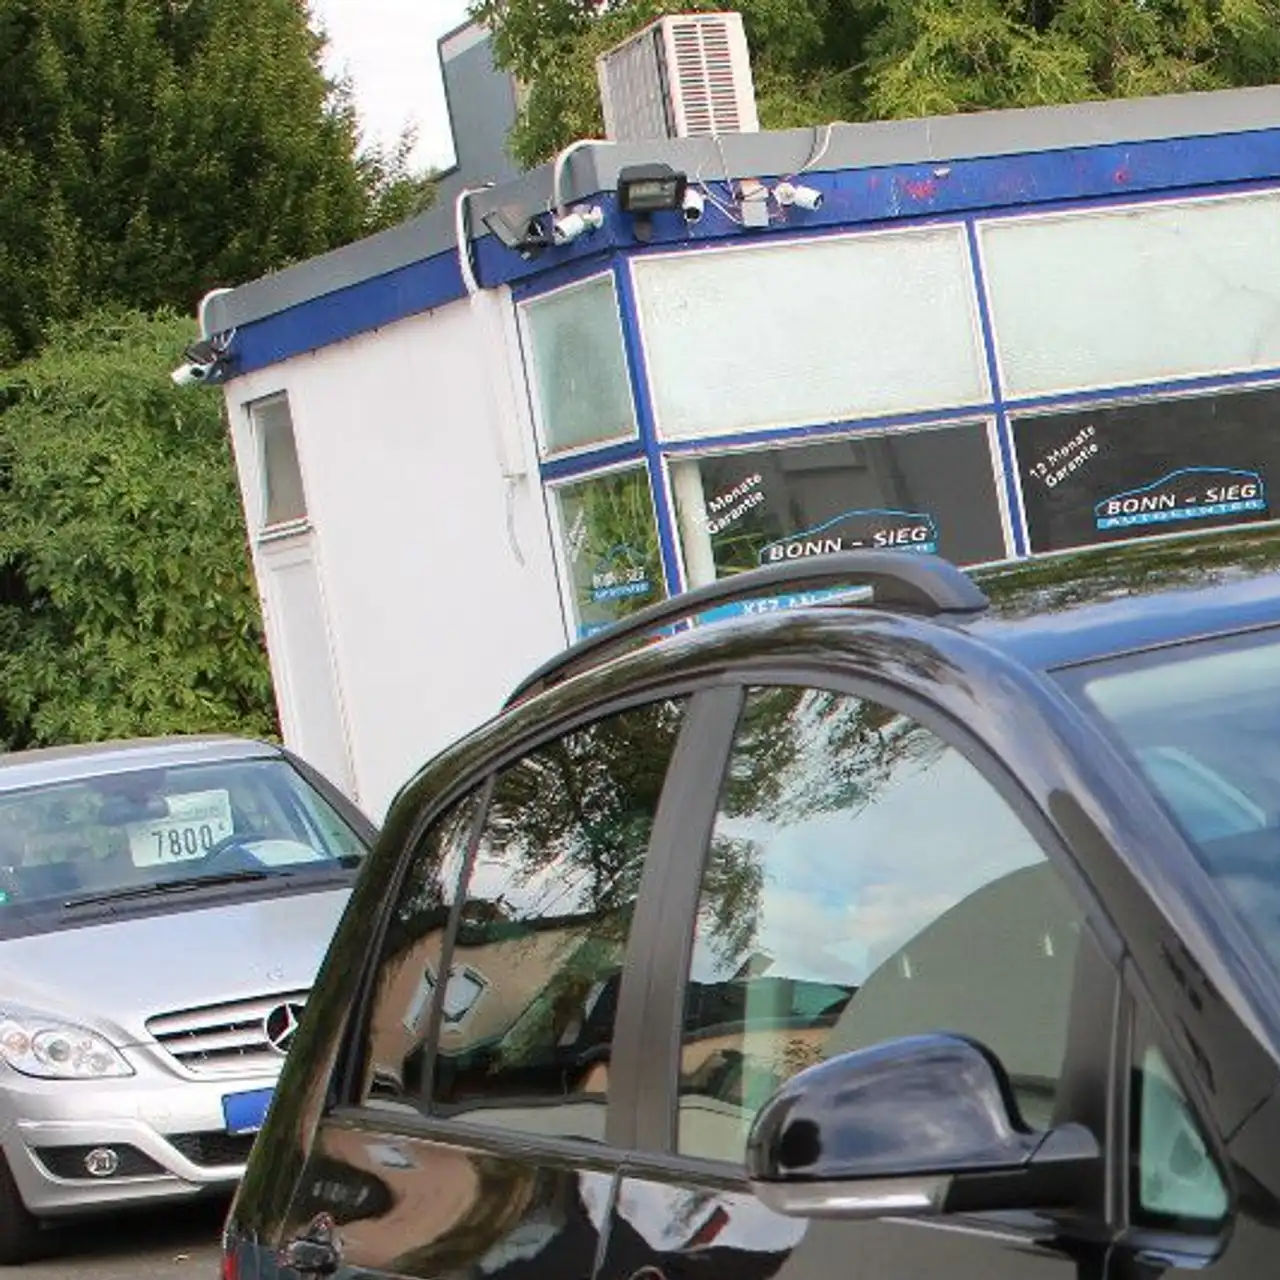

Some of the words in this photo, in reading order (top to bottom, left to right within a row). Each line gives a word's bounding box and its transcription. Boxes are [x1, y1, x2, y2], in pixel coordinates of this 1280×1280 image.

[1047, 425, 1095, 467] Monate
[1045, 443, 1099, 488] Garantie
[708, 473, 763, 512] Monate
[1106, 493, 1176, 516] BONN
[1204, 484, 1257, 503] SIEG
[704, 491, 765, 535] Garantie
[1105, 500, 1259, 526] AUTOCENTER
[770, 538, 842, 561] BONN
[872, 526, 928, 548] SIEG
[152, 824, 213, 860] 7800
